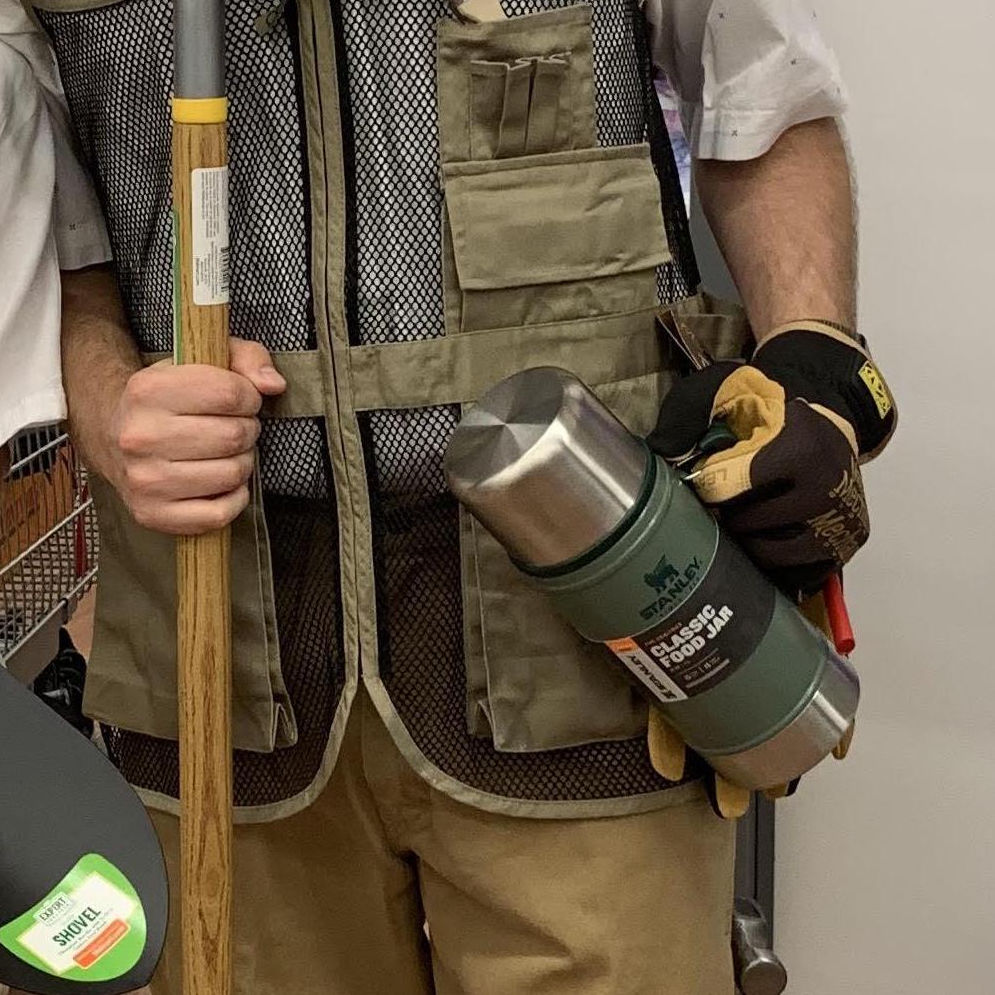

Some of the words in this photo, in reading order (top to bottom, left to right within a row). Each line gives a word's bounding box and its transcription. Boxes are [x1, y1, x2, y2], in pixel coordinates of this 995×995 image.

[639, 557, 700, 620] STANLEY
[650, 604, 716, 657] CLASSIC
[659, 635, 705, 668] FOOD
[706, 605, 733, 639] JAR
[38, 897, 67, 922] EXPERT
[52, 906, 101, 947] SHOVEL
